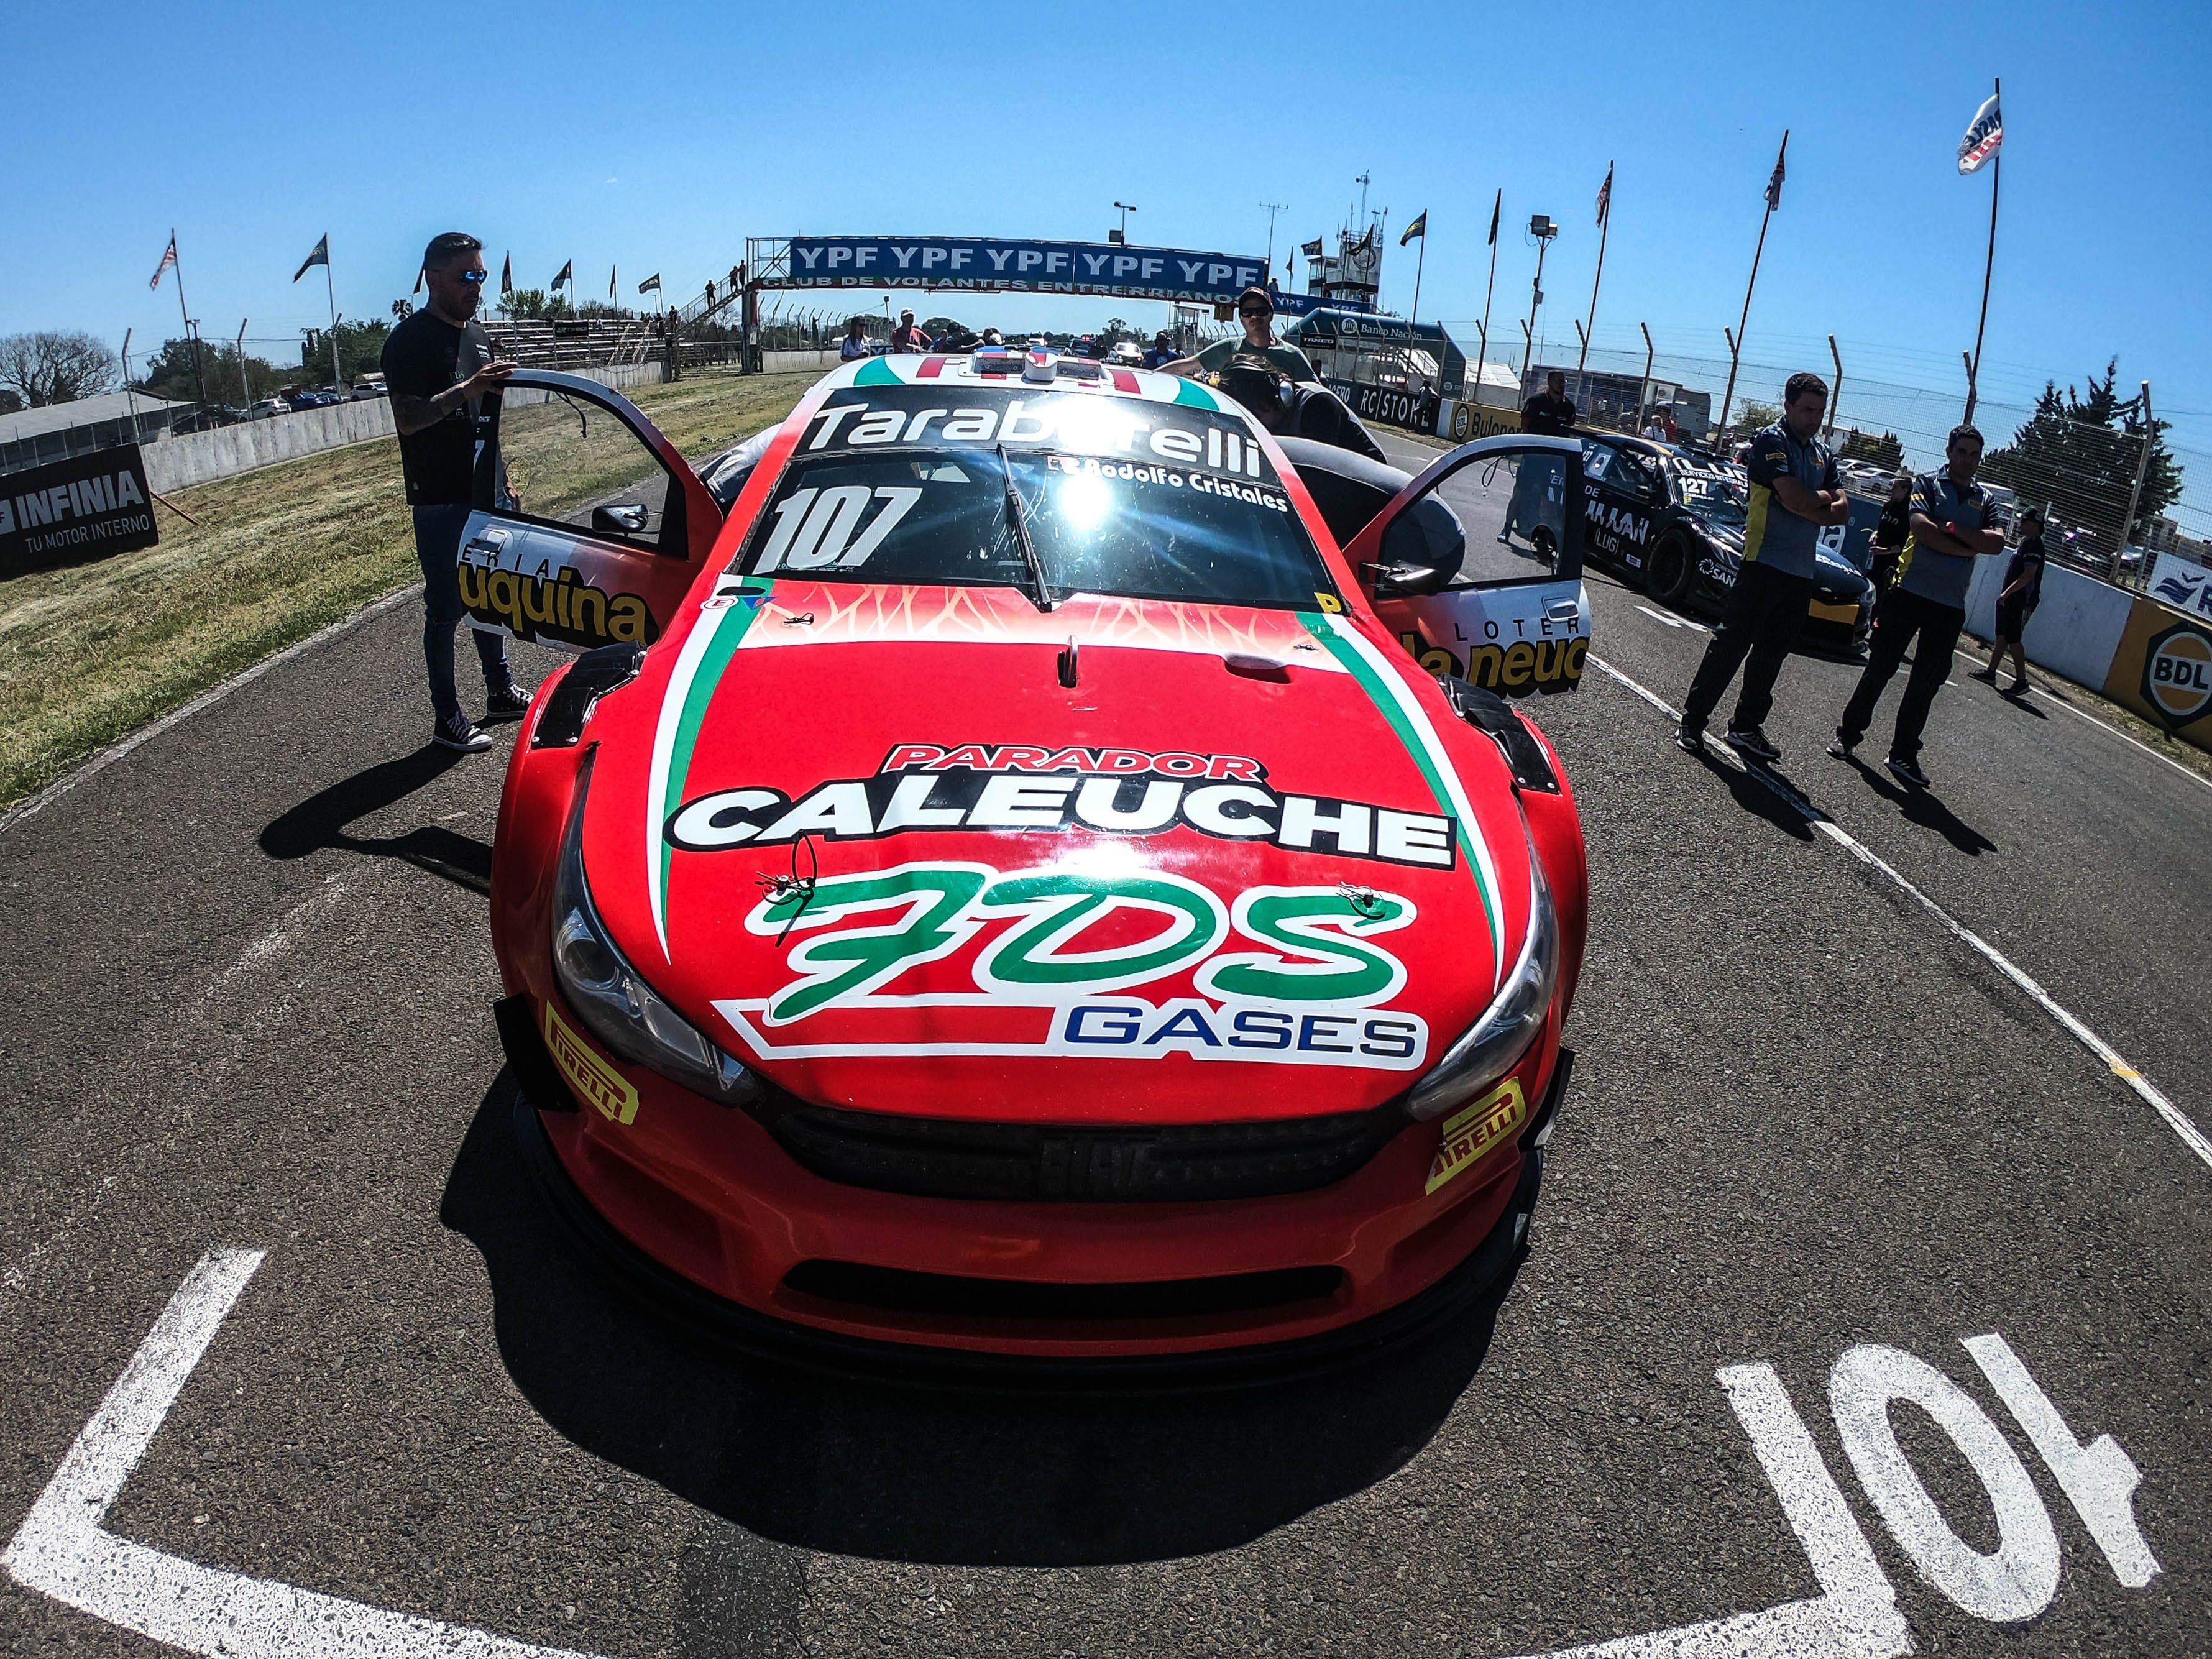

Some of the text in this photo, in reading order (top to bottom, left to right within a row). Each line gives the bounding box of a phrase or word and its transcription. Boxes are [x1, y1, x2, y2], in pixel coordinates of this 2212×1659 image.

[763, 277, 833, 287] CLUB
[841, 277, 874, 287] DE
[883, 277, 1029, 290] VOLANTES
[797, 247, 1258, 287] YPF YPF YPF YPF YPF
[1277, 297, 1304, 307] YPF
[1361, 323, 1388, 336] Banco
[16, 470, 144, 528] INFINIA
[1083, 458, 1288, 513] Rodolfo Cristales
[1584, 485, 1601, 498] DE
[1678, 476, 1708, 495] 127
[25, 513, 149, 553] TU MOTOR INTERNO
[751, 486, 924, 576] 107
[1712, 568, 1737, 587] SAN
[1454, 618, 1579, 642] LOTER
[2154, 656, 2208, 691] BDL
[881, 745, 1262, 781] PARADOR
[674, 774, 1451, 866] CALEUCHE
[1063, 1006, 1416, 1058] GASES
[550, 1013, 628, 1119] PIRELLI
